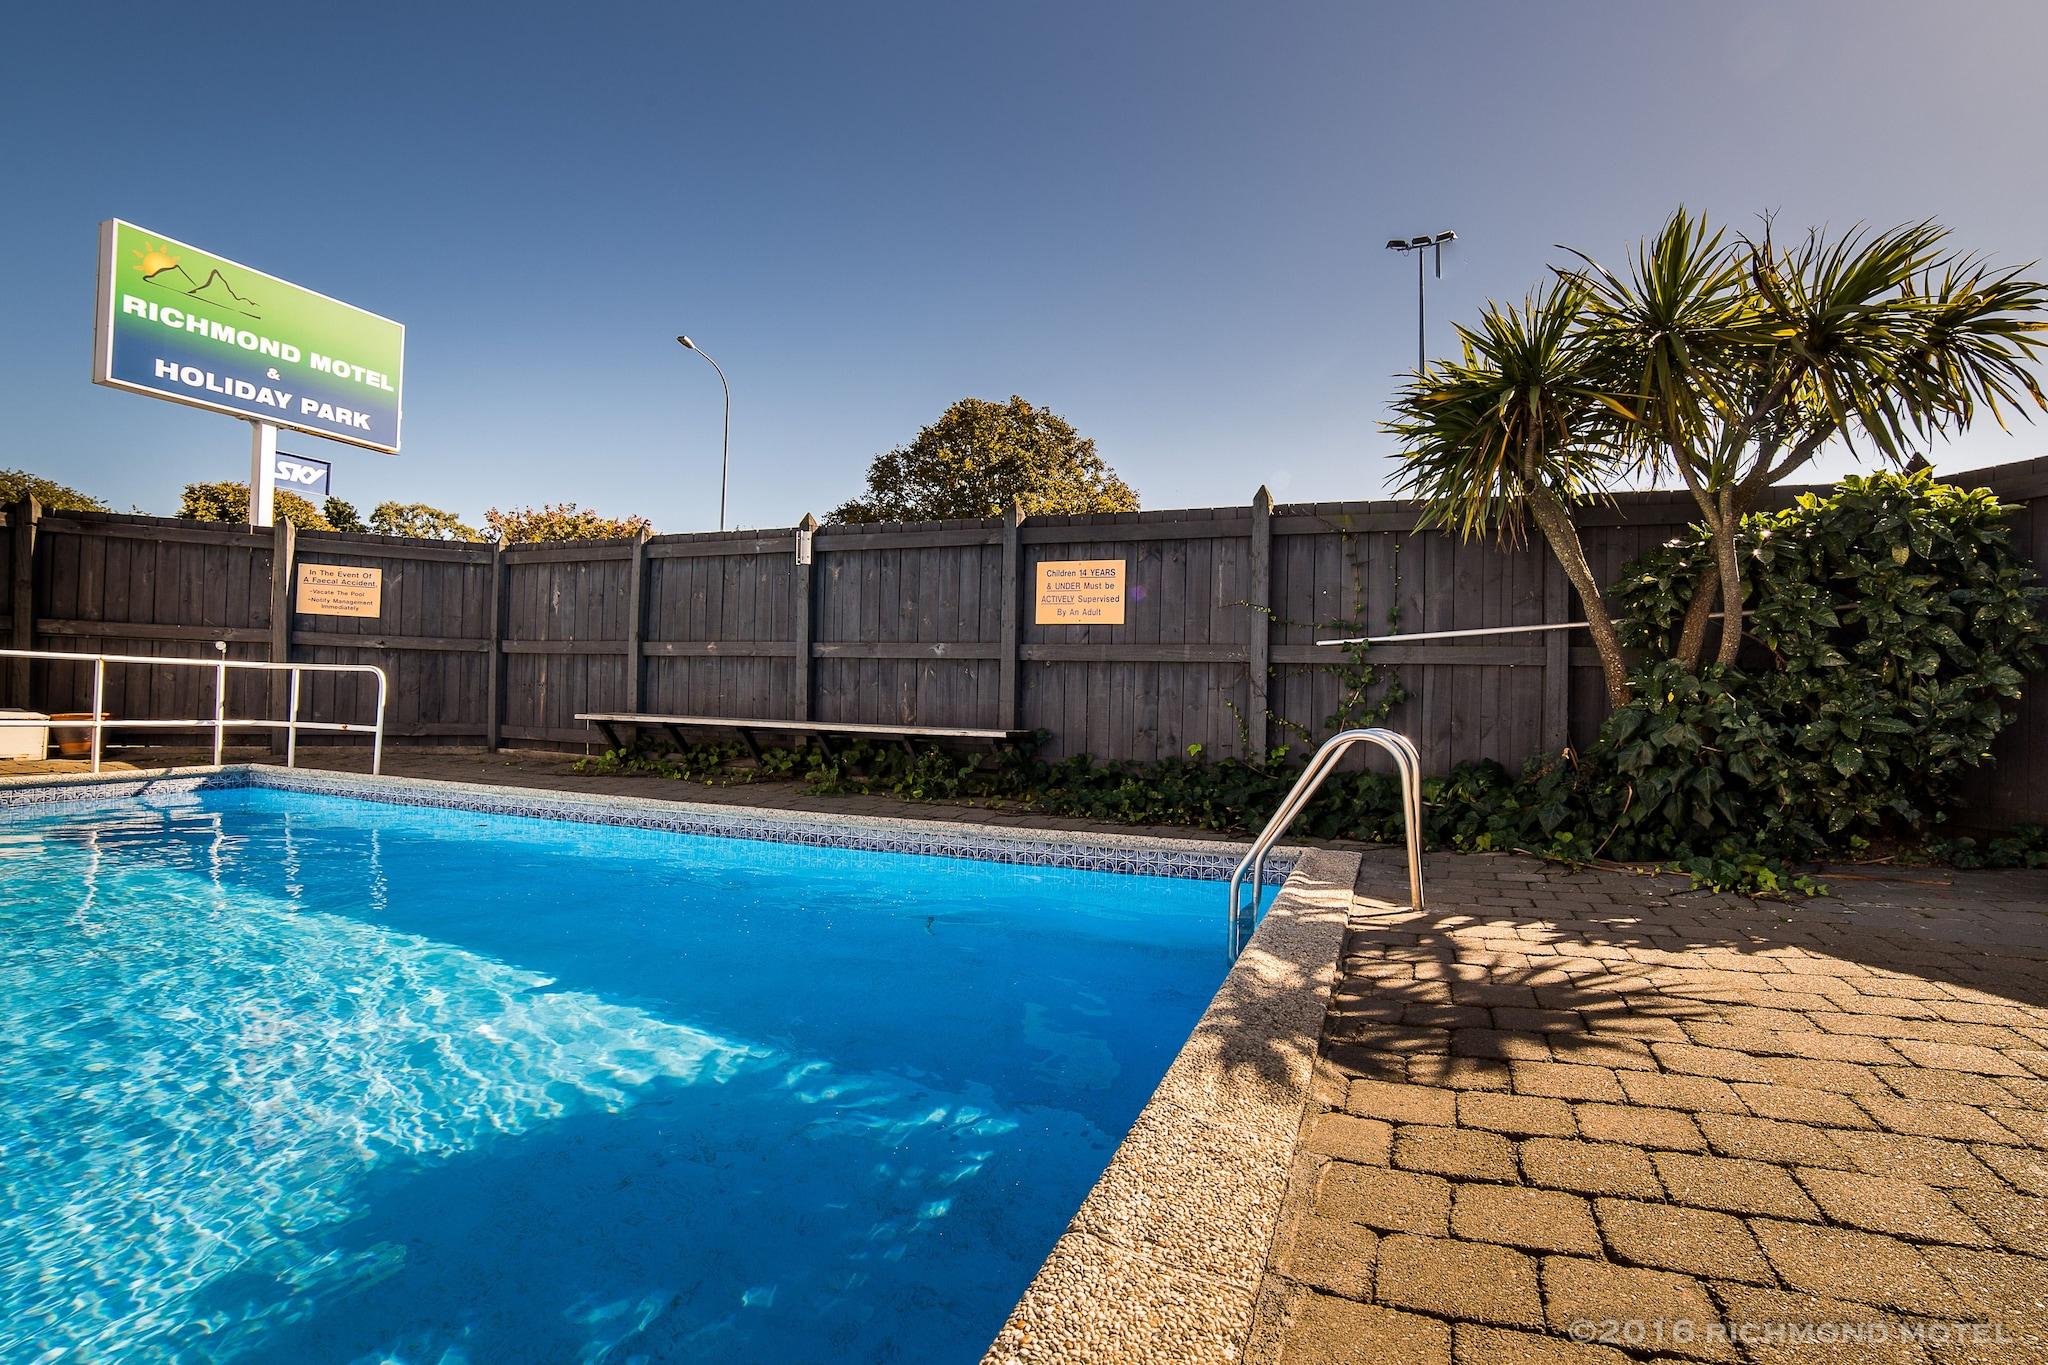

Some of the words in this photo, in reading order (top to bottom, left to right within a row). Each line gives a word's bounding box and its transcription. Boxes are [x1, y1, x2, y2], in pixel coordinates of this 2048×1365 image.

[123, 294, 301, 363] RICHMOND
[310, 352, 394, 392] MOTEL
[266, 367, 281, 381] &
[154, 358, 292, 410] HOLIDAY
[301, 398, 371, 431] PARK
[274, 460, 327, 485] SKY
[320, 569, 334, 577] The
[337, 571, 360, 579] Event
[1046, 569, 1076, 577] Children
[1079, 569, 1087, 577] 14
[1090, 568, 1116, 577] YEARS
[312, 577, 338, 585] Faecal
[1055, 582, 1081, 590] UNDER
[1083, 582, 1102, 590] Must
[1105, 581, 1115, 589] be
[1041, 595, 1075, 603] ACTIVELY
[1077, 595, 1120, 604] Supervised
[1057, 608, 1067, 617] By
[1069, 608, 1079, 616] An
[1082, 608, 1101, 616] Adult
